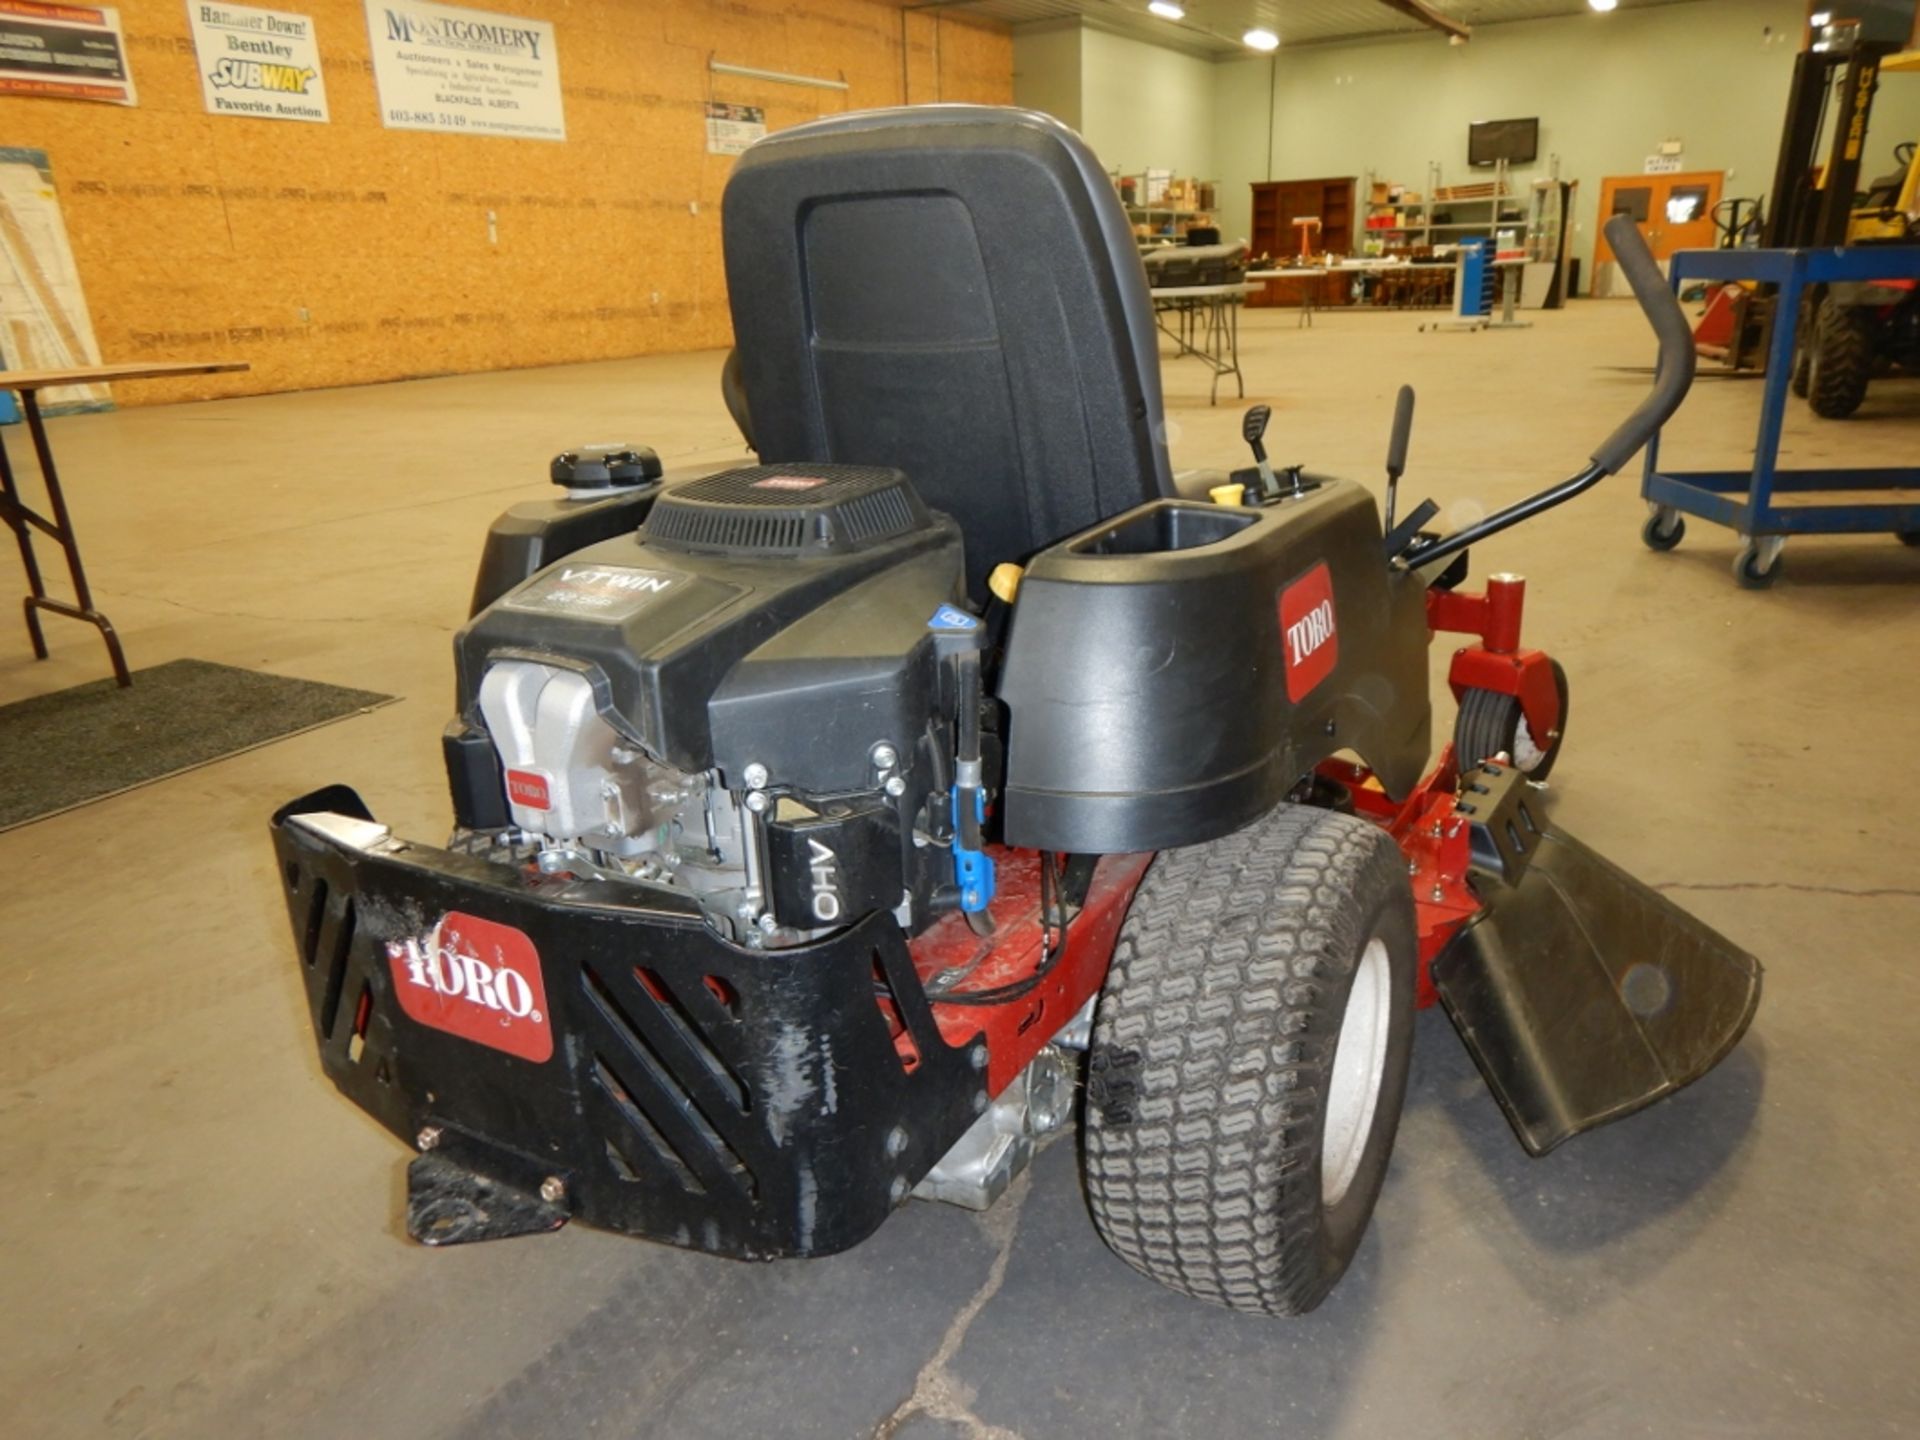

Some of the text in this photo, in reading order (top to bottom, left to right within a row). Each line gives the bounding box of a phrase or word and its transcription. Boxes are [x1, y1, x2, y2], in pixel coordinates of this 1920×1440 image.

[267, 15, 307, 35] Down!
[384, 9, 541, 60] MONTGOMERY
[225, 34, 294, 59] Bentley
[208, 57, 318, 94] SUBWAY
[397, 51, 451, 66] Auctioneers
[466, 58, 490, 71] Sales
[494, 63, 543, 77] Management
[214, 97, 322, 118] Favorite Auction
[488, 99, 520, 110] ALBERTA
[389, 109, 466, 126] 403-885 5149
[1287, 599, 1332, 667] TORO
[510, 781, 547, 799] TORO
[807, 838, 839, 920] OHV
